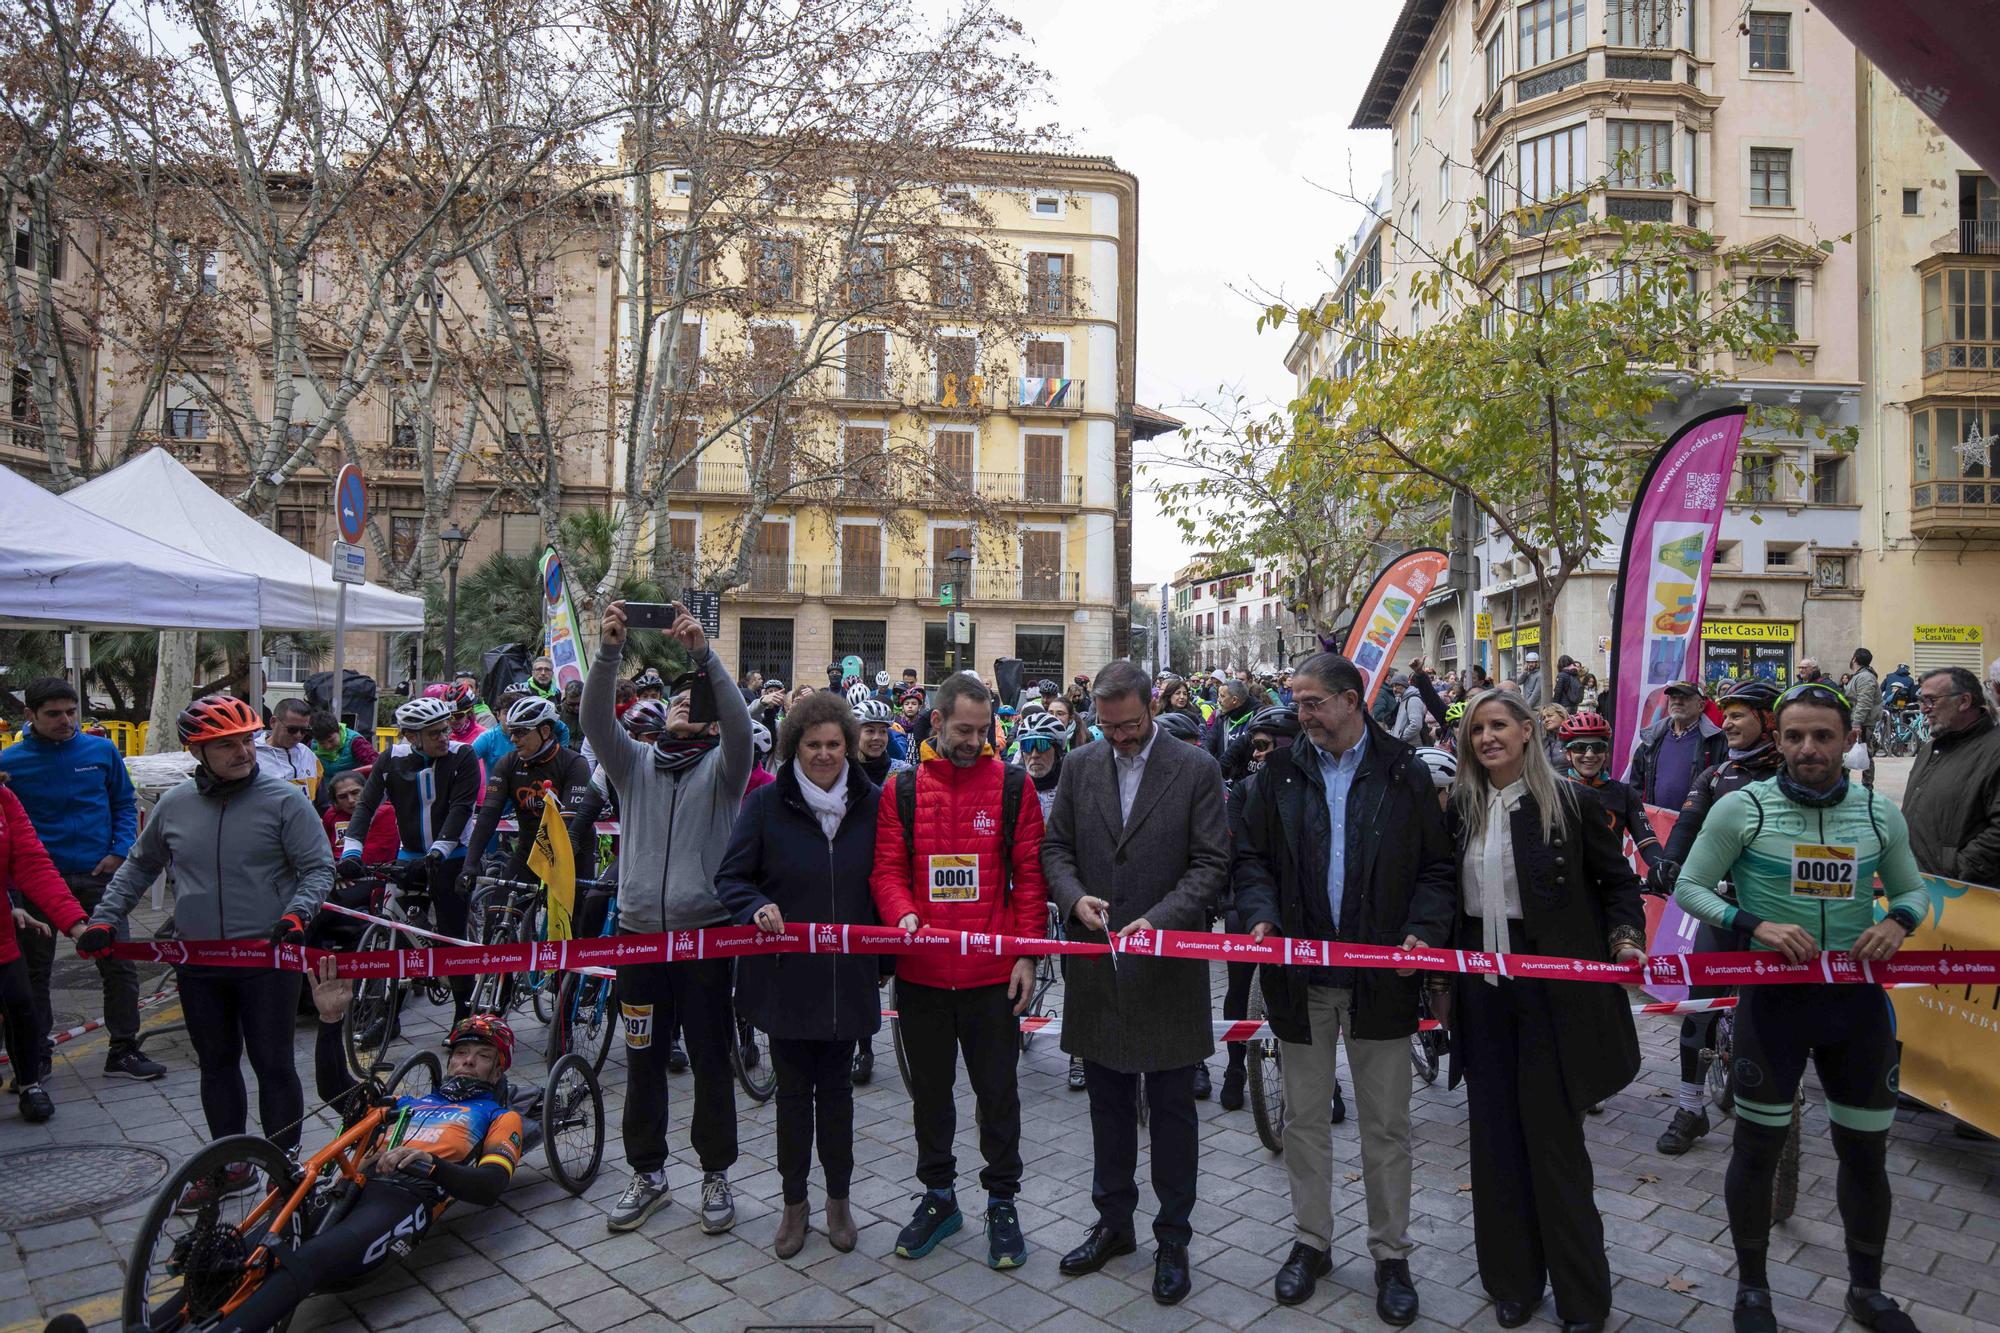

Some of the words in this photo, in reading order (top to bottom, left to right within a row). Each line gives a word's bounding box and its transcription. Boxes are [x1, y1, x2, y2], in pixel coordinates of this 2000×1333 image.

[1701, 623, 1733, 635] arket
[1736, 625, 1764, 636] Casa
[1767, 625, 1789, 636] Vila
[1916, 626, 1937, 634] Super
[1939, 626, 1964, 634] Market
[973, 819, 991, 828] IME
[1797, 861, 1853, 883] 0002
[935, 869, 974, 886] 0001
[715, 937, 753, 948] Ajuntament
[765, 935, 775, 943] de
[776, 934, 799, 942] Palma
[818, 934, 837, 943] IME
[861, 935, 902, 944] Ajuntament
[914, 936, 925, 944] de
[925, 936, 950, 944] Palma
[969, 934, 990, 944] IME
[1129, 938, 1150, 946] IME
[675, 941, 694, 950] IME
[1175, 941, 1220, 951] Ajuntament
[1233, 944, 1245, 952] de
[1246, 944, 1273, 953] Palma
[247, 950, 267, 958] Palma
[539, 951, 557, 961] IME
[578, 948, 614, 958] Ajuntament
[625, 946, 635, 955] de
[636, 945, 658, 953] Palma
[1294, 947, 1317, 957] IME
[281, 952, 299, 963] IME
[444, 957, 481, 967] Ajuntament
[491, 954, 500, 963] de
[501, 954, 522, 963] Palma
[1343, 952, 1389, 961] Ajuntament
[1417, 955, 1445, 963] Palma
[360, 961, 368, 969] de
[369, 961, 390, 969] Palma
[407, 959, 424, 968] IME
[1468, 958, 1491, 968] IME
[1521, 961, 1570, 971] Ajuntament
[1586, 964, 1599, 972] de
[1600, 964, 1630, 973] Palma
[1832, 962, 1857, 972] IME
[1886, 964, 1936, 973] Ajuntament
[1951, 963, 1965, 973] de
[1966, 964, 1995, 973] Palma
[1653, 965, 1677, 976] IME
[1705, 965, 1752, 974] Ajuntament
[1767, 964, 1779, 973] de
[1780, 963, 1808, 973] Palma
[1919, 995, 1956, 1016] SANT
[624, 1017, 648, 1035] 397
[362, 1203, 428, 1265] GSG
